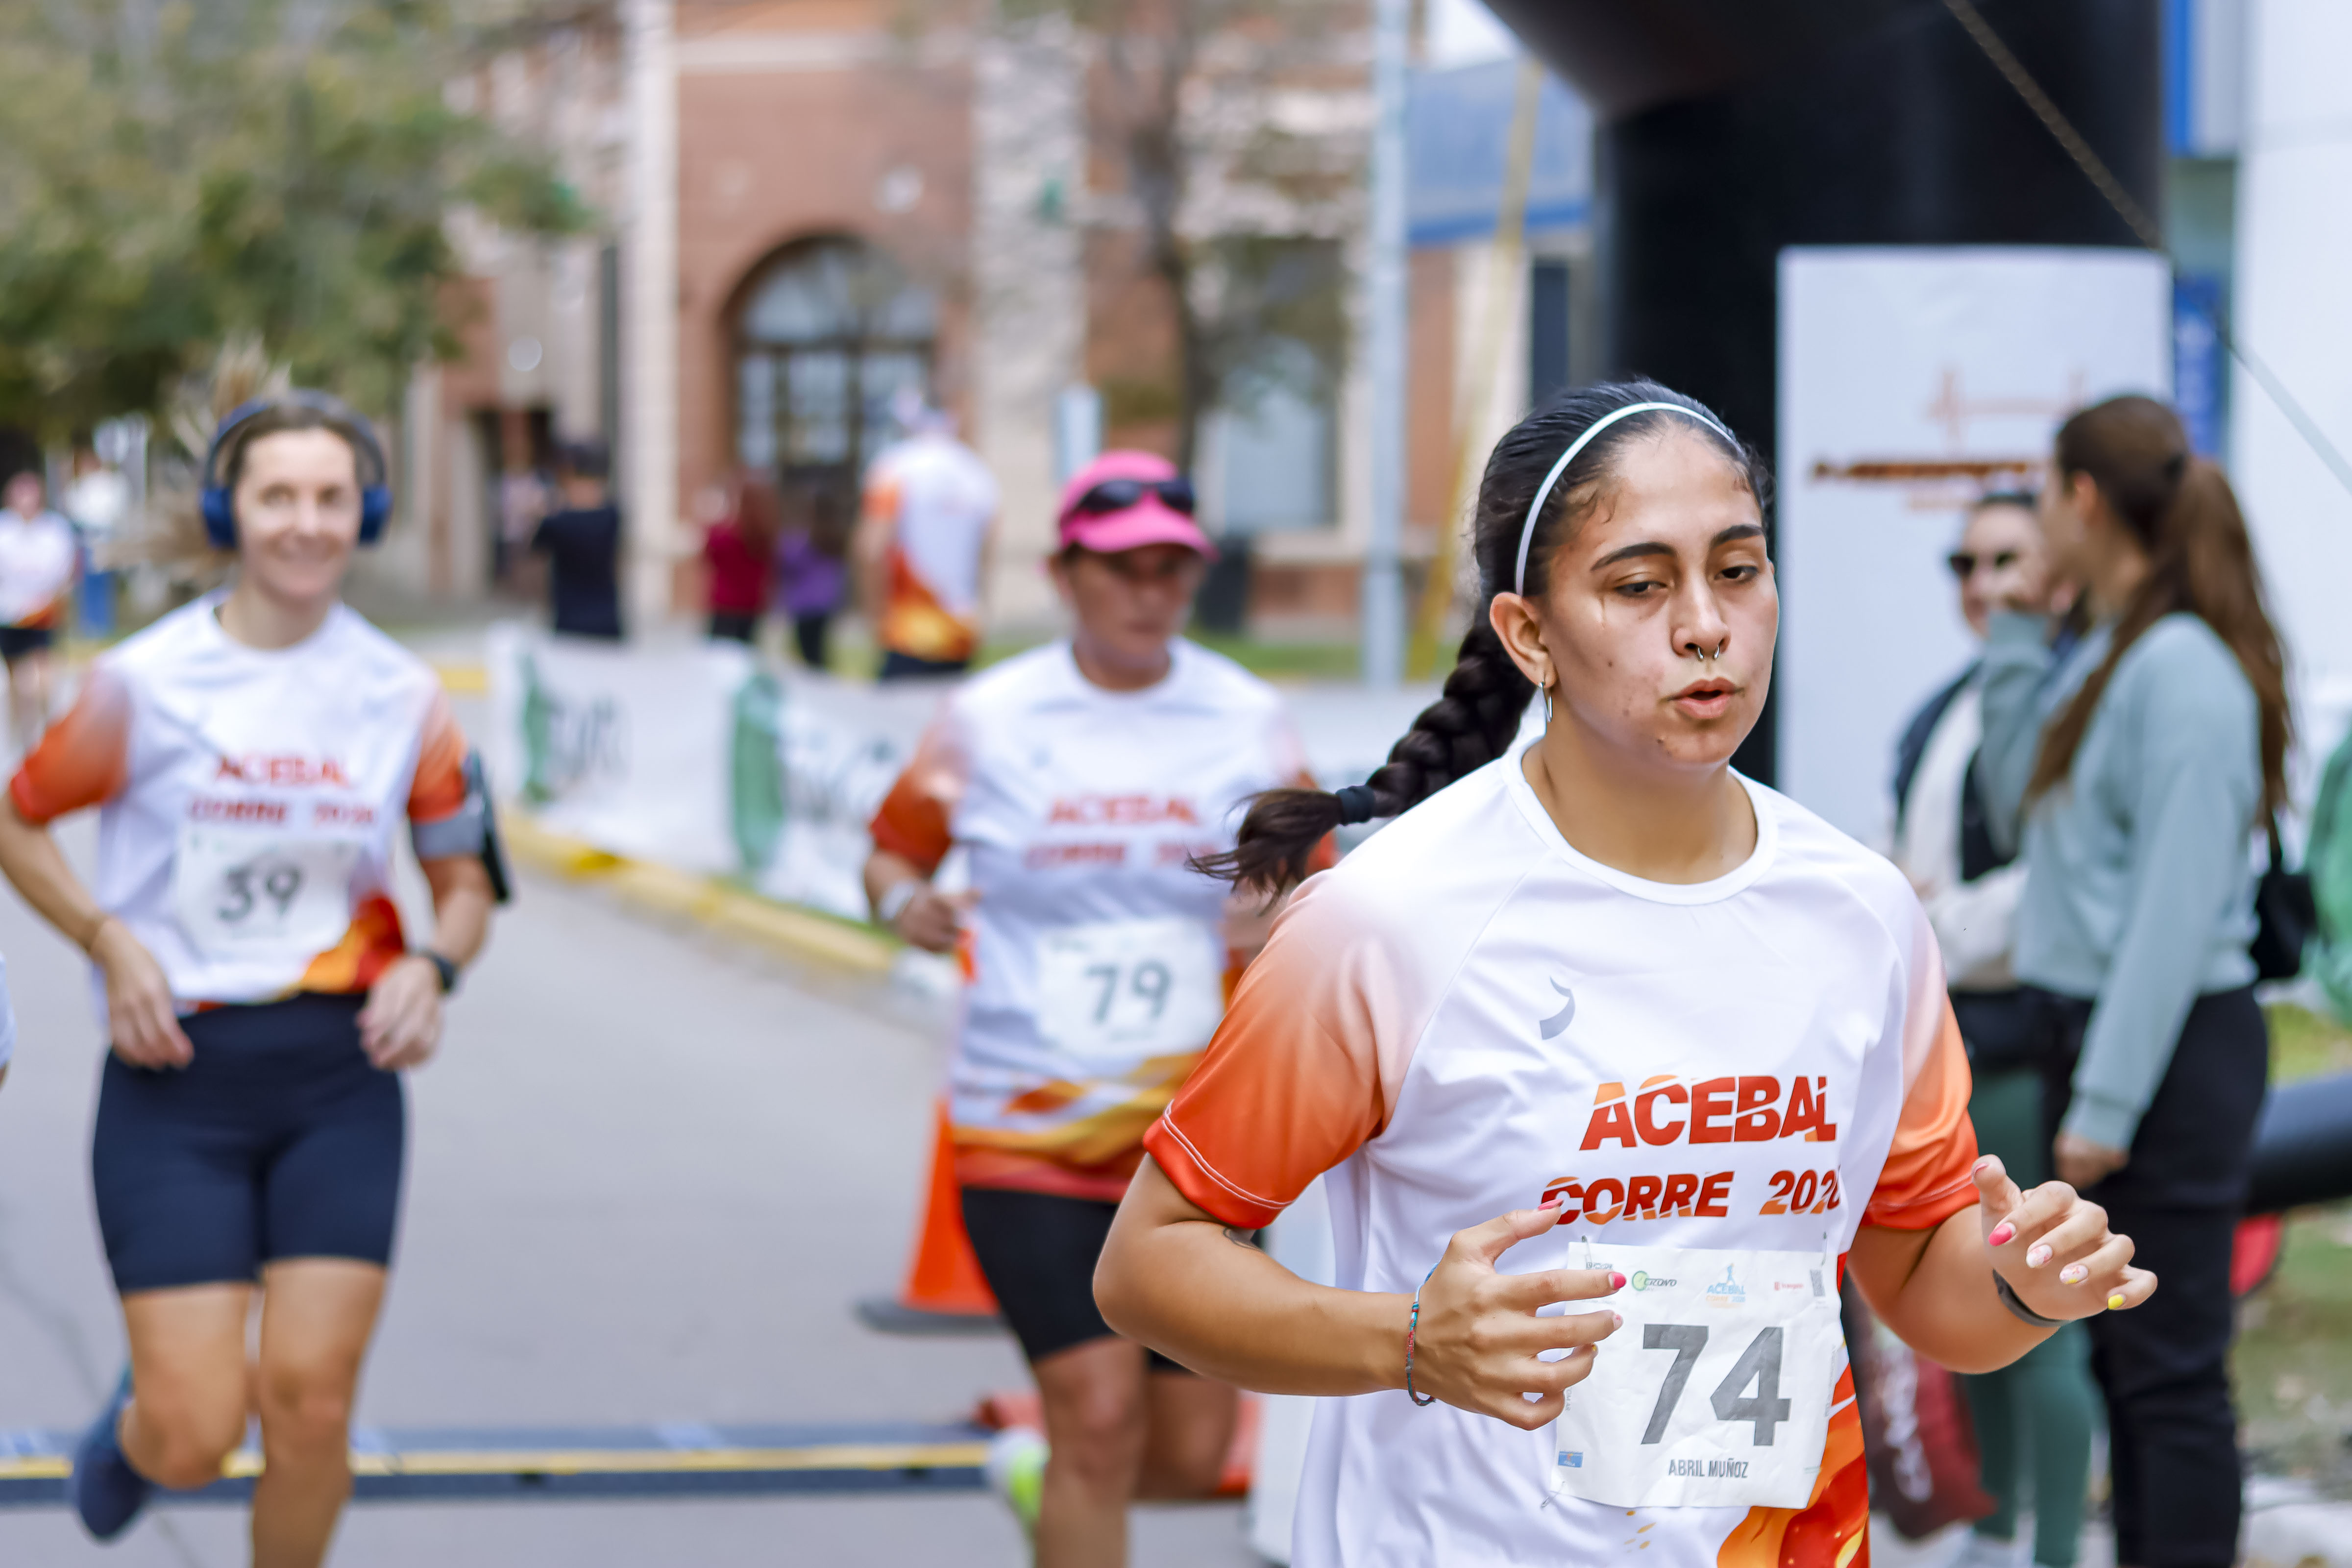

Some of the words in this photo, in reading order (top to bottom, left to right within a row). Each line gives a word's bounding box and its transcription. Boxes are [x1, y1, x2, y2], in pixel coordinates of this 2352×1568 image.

[216, 861, 302, 922] 39
[1080, 958, 1174, 1024] 79
[1579, 1075, 1838, 1151] ACEBAL
[1541, 1171, 1735, 1225] CORRE
[1707, 1283, 1746, 1295] ACEBAL
[1641, 1323, 1792, 1446] 74
[1668, 1459, 1705, 1477] ABRIL
[1708, 1458, 1749, 1478] MUÑOZ
